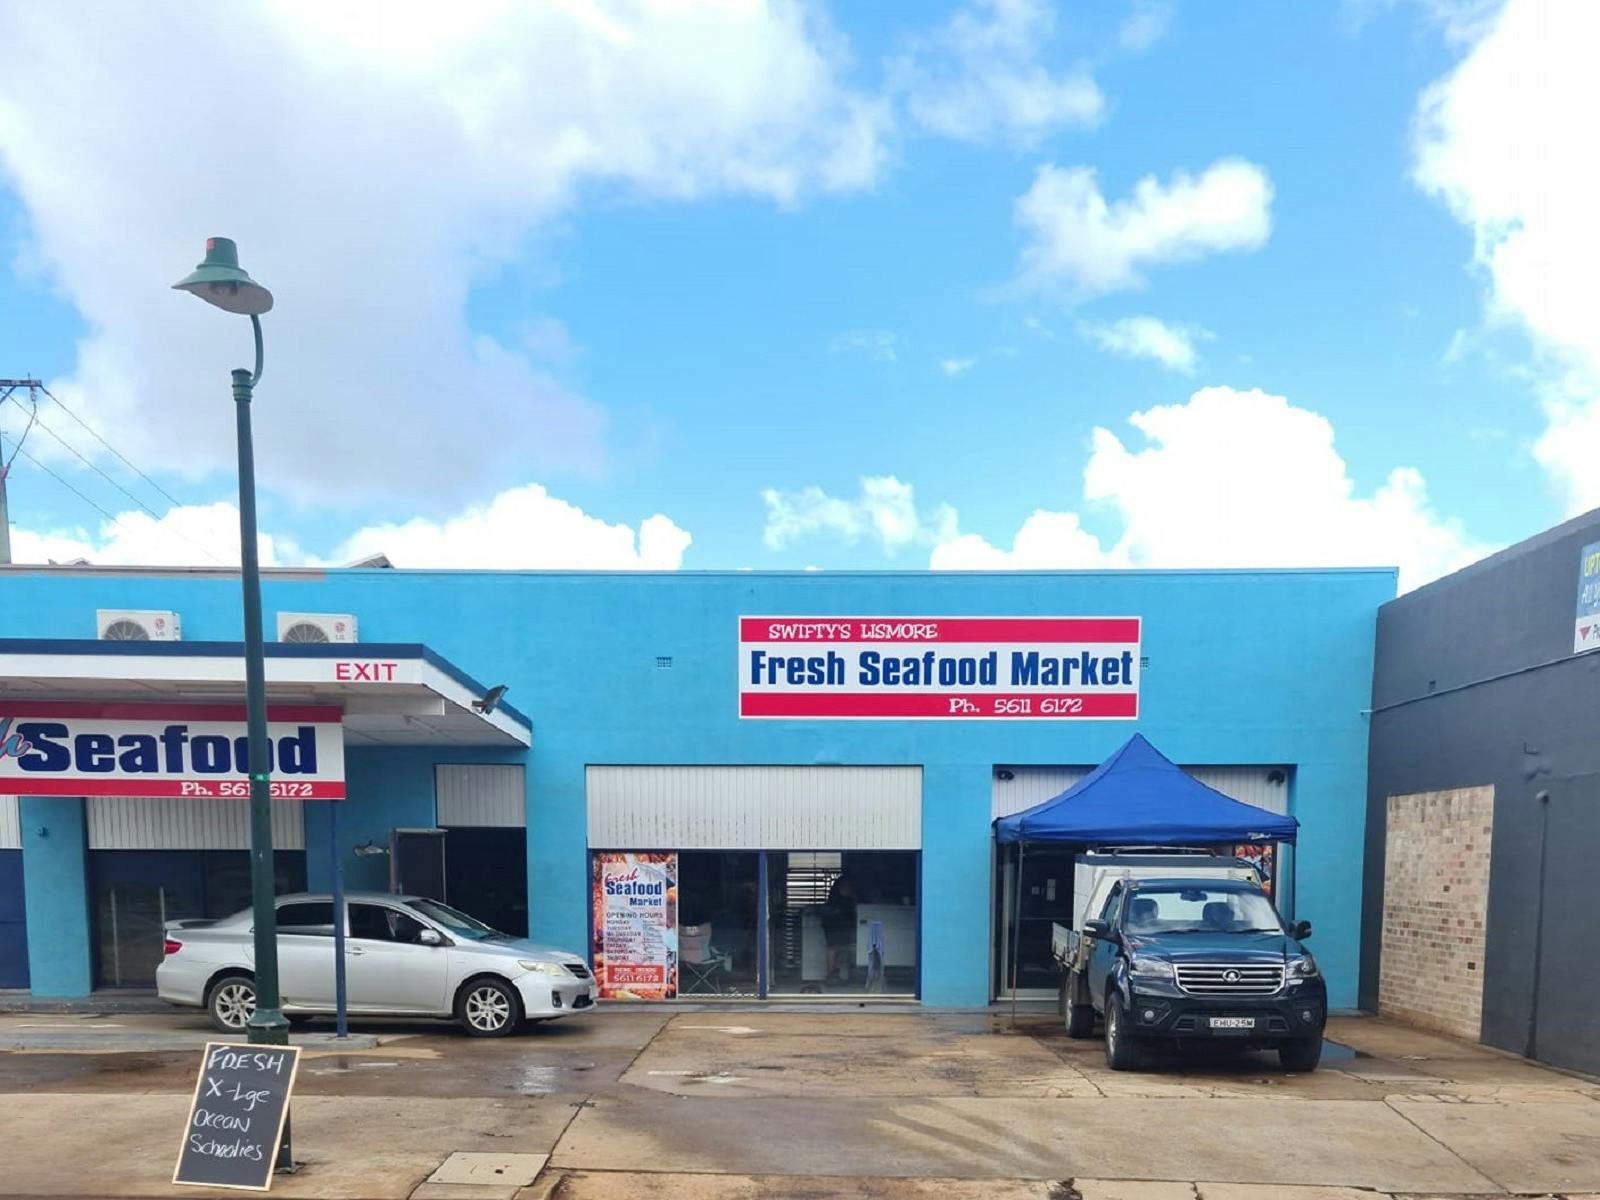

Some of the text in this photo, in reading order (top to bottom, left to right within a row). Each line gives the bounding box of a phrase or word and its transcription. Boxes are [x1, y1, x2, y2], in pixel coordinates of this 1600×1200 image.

[768, 623, 938, 639] SWIFTY'S LISMORE
[335, 662, 397, 681] EXIT
[751, 651, 1133, 685] Fresh Seafood Market
[949, 698, 1083, 713] Ph. 5611 6172
[181, 782, 213, 796] Ph.
[219, 783, 251, 796] 561
[606, 881, 662, 896] Seafood
[629, 897, 662, 906] Market
[190, 1134, 263, 1161] Schoolies
